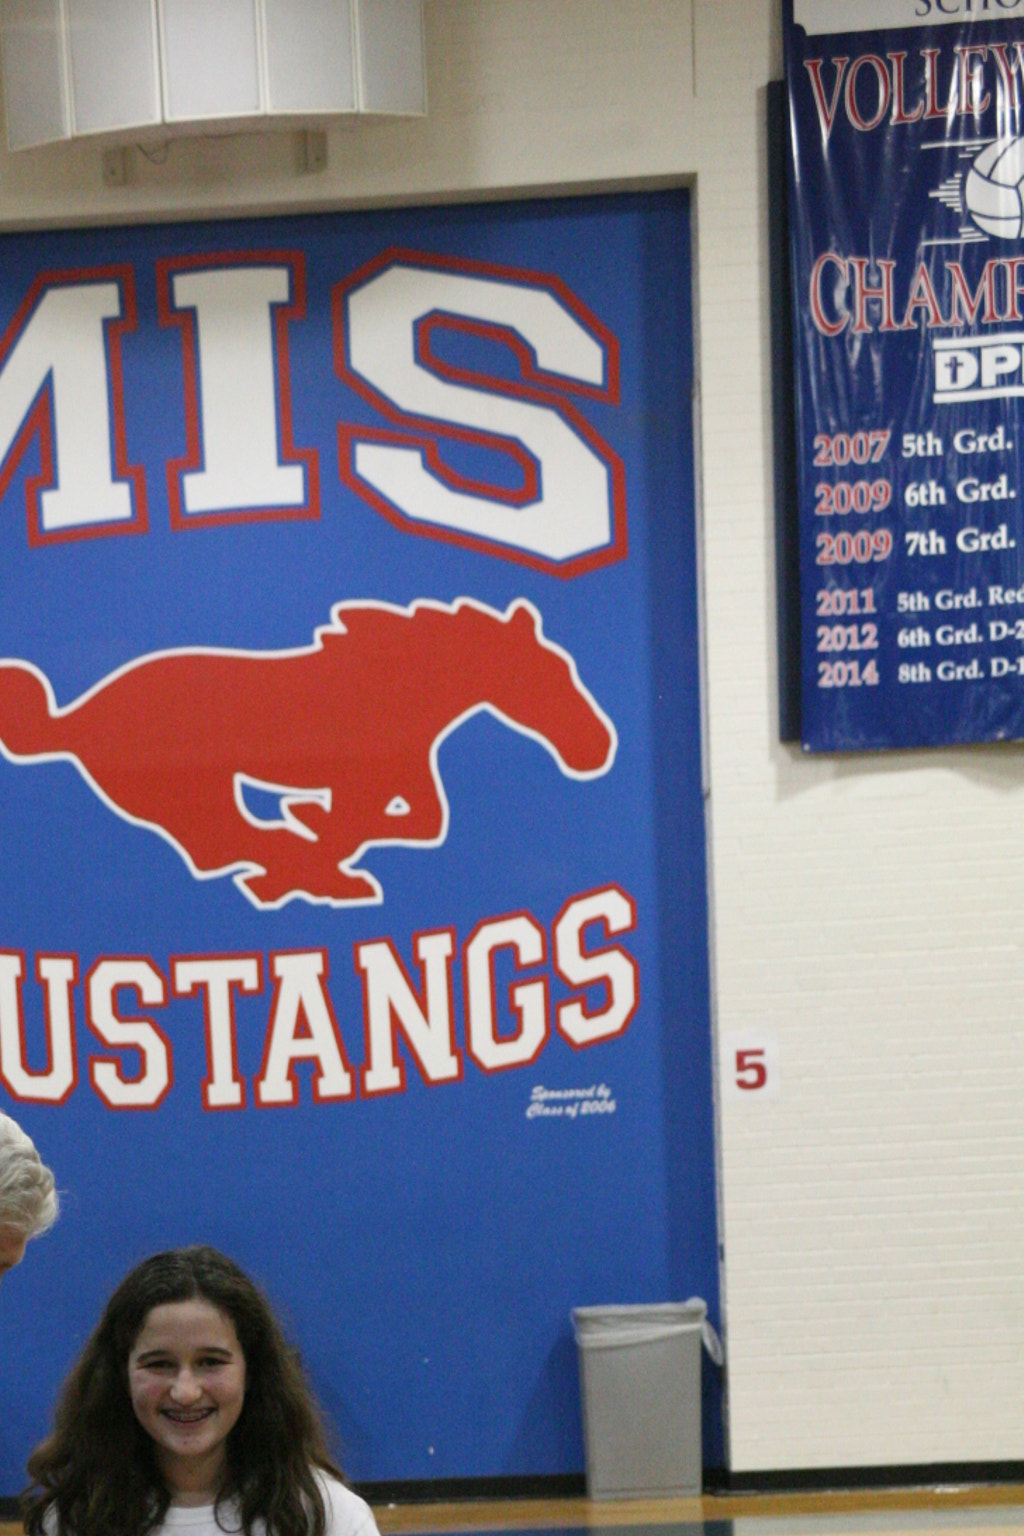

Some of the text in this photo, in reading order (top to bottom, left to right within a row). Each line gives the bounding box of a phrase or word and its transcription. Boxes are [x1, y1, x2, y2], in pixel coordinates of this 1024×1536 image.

[935, 344, 1024, 391] DP
[813, 426, 1013, 466] 2007 5th Grd.
[814, 475, 1016, 515] 2009 6th Grd.
[816, 525, 1016, 565] 2009 7th Grd.
[816, 588, 877, 616] 2011
[897, 591, 930, 613] 5th
[935, 586, 983, 610] Grd.
[817, 622, 879, 652] 2012
[897, 627, 930, 648] 6th
[935, 623, 984, 646] Grd.
[818, 659, 880, 688] 2014
[898, 663, 931, 684] 8th
[937, 658, 985, 682] Grd.
[736, 1049, 767, 1091] 5
